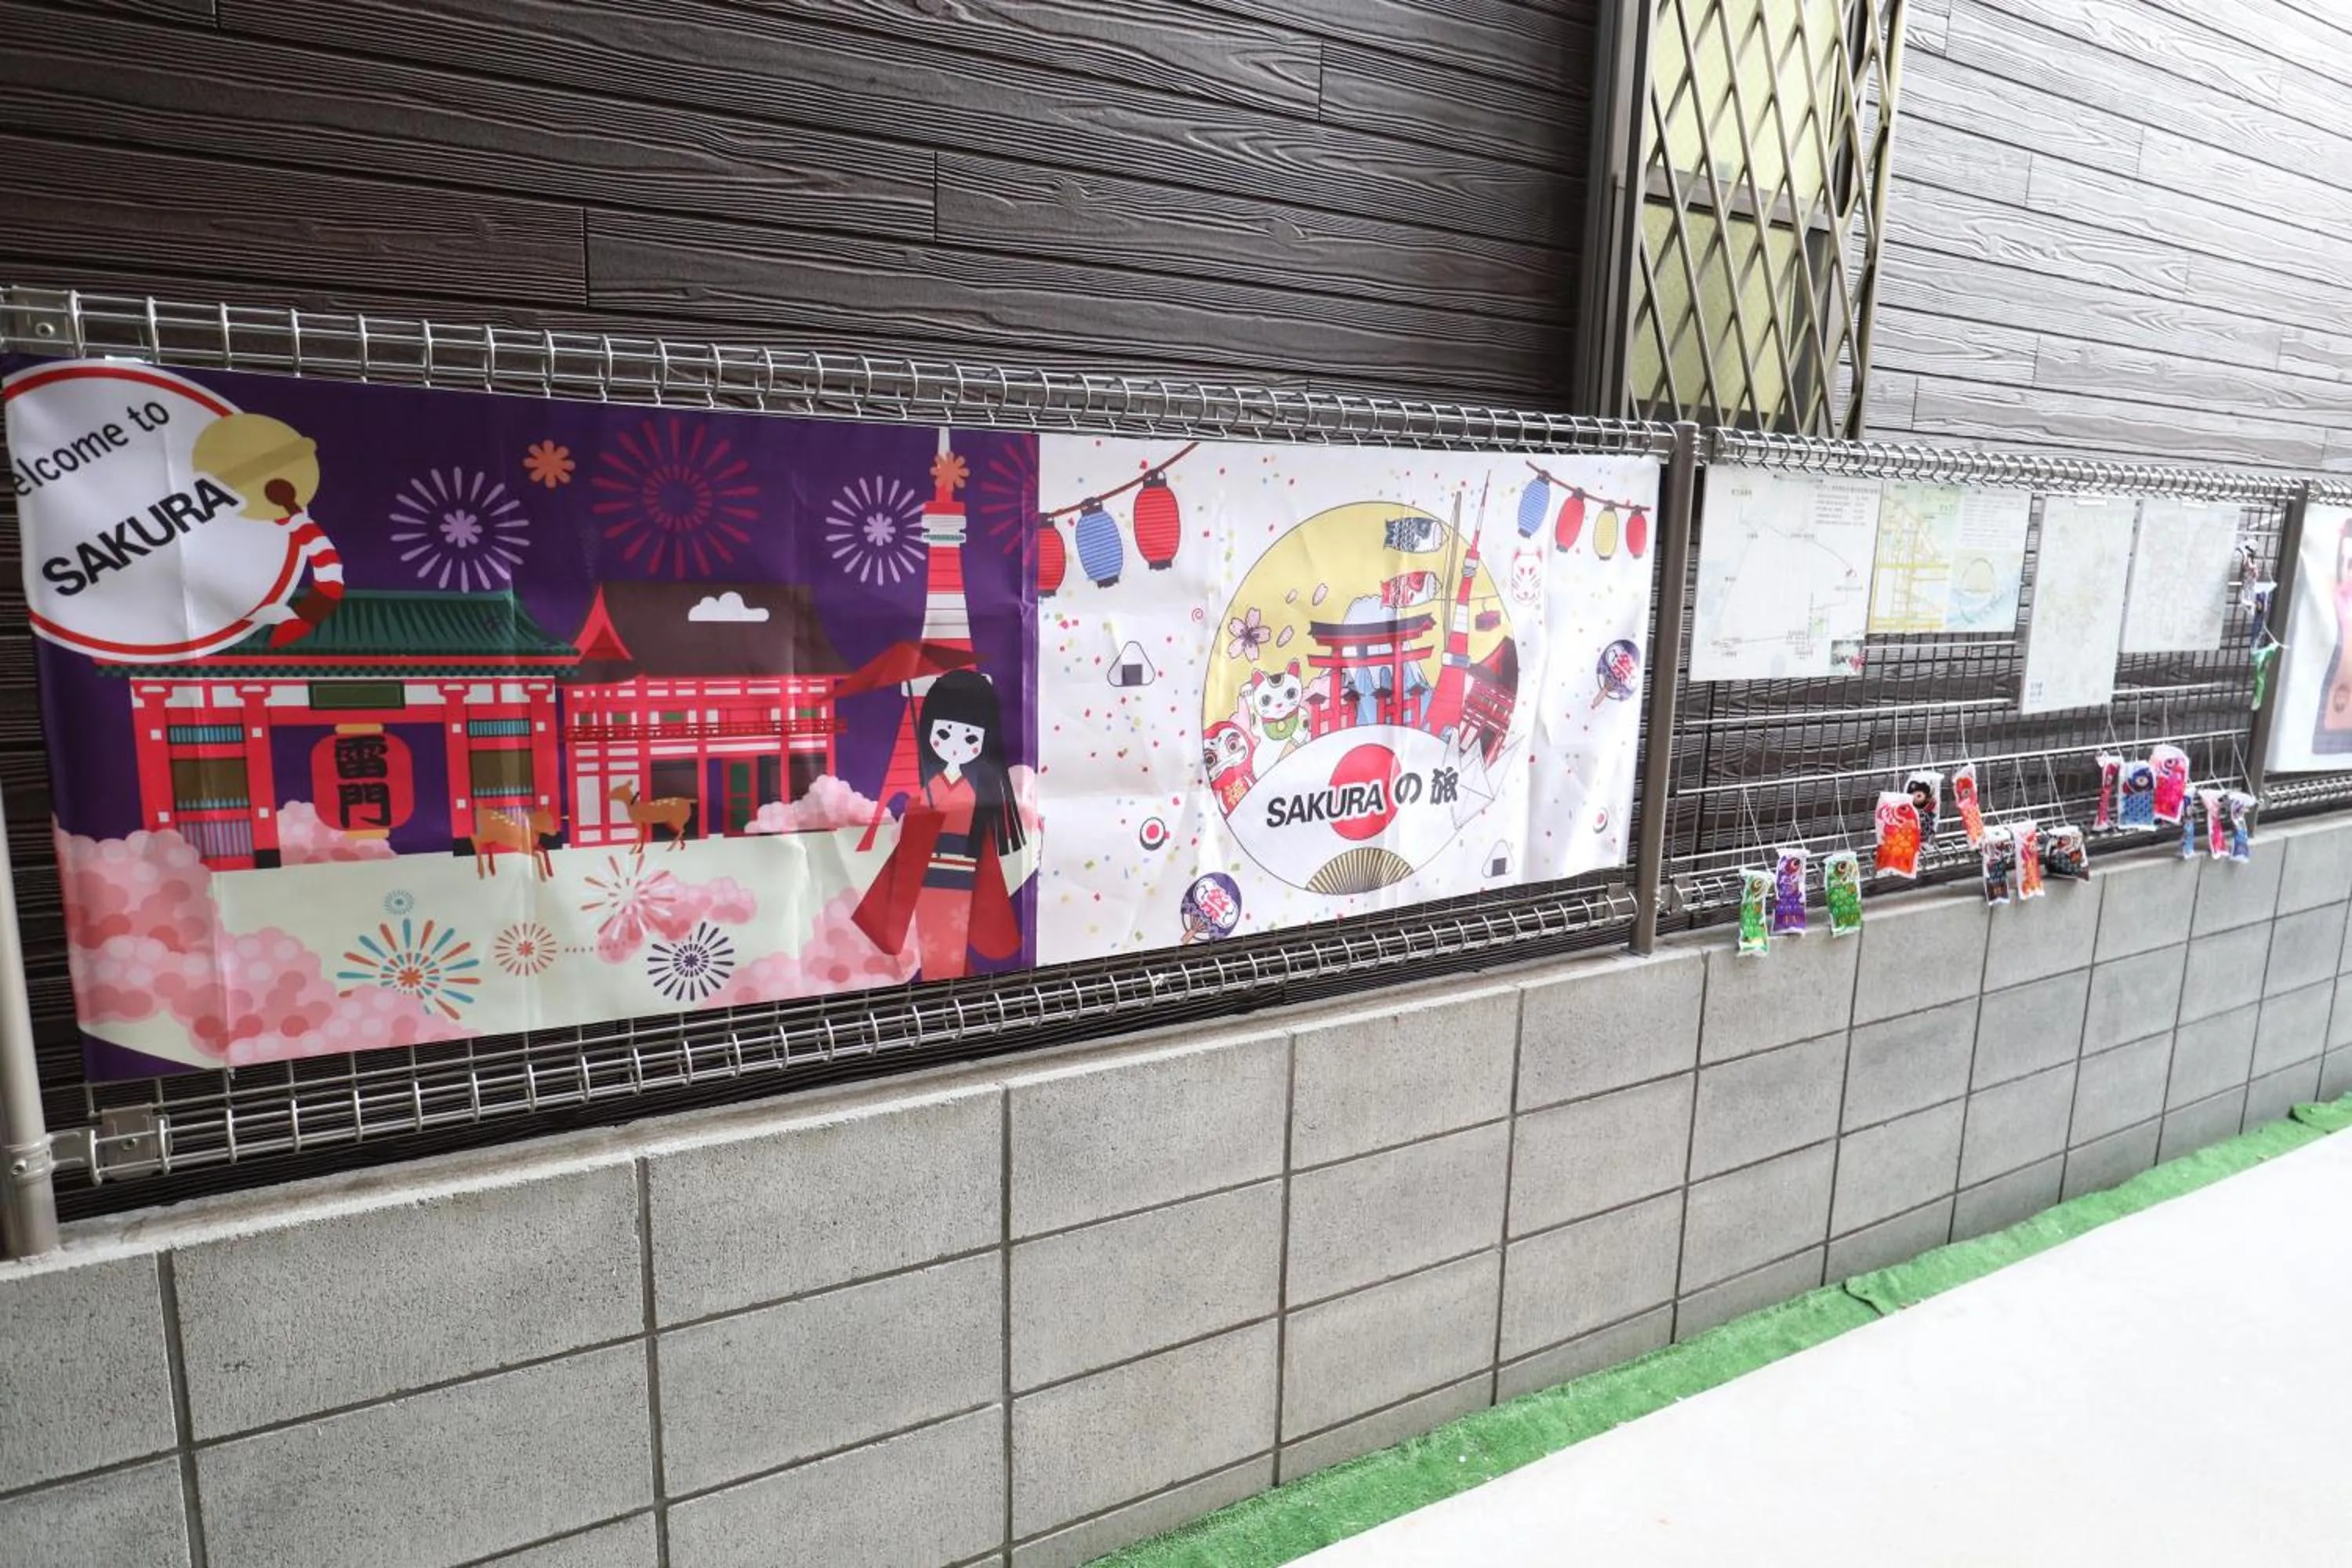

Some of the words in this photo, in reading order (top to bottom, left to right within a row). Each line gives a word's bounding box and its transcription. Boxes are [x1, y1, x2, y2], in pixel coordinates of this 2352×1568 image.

[126, 401, 169, 433] to
[42, 478, 239, 597] SAKURA
[335, 735, 392, 829] 雷門
